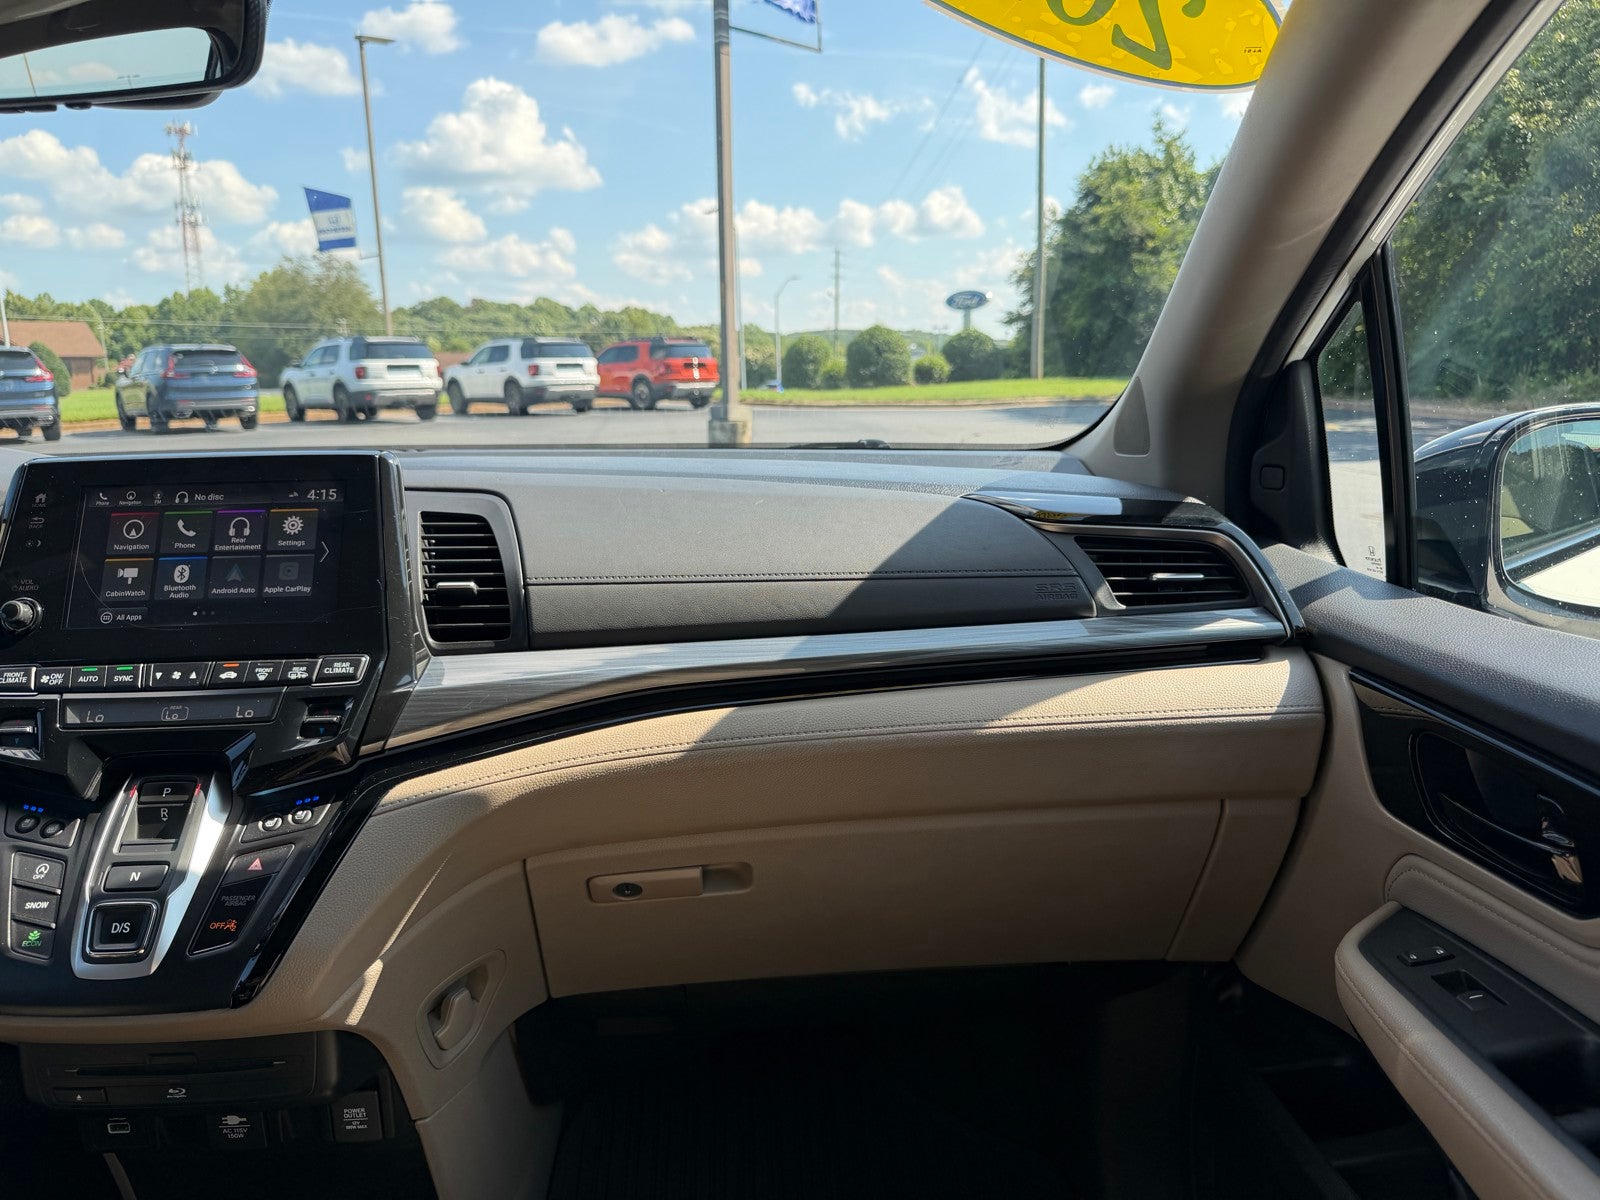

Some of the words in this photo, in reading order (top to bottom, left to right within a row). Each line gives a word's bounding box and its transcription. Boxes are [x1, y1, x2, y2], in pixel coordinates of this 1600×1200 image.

[194, 493, 206, 501] No
[207, 493, 225, 501] disc
[306, 488, 337, 501] 4:15
[113, 543, 150, 551] Navigation
[277, 539, 306, 547] Settings
[163, 584, 197, 592] Bluetooth
[263, 586, 284, 594] Apple
[285, 585, 311, 594] CarPlay
[1035, 583, 1077, 592] SRS
[105, 590, 146, 598] CabinWatch
[1036, 593, 1078, 601] AIRBAG
[126, 614, 142, 622] Apps
[323, 666, 355, 674] CLIMATE
[48, 678, 64, 686] OFF
[77, 675, 99, 683] AUTO
[86, 710, 105, 723] Lo
[165, 710, 179, 720] Lo
[235, 705, 255, 719] Lo
[162, 787, 172, 797] P
[160, 807, 169, 818] R
[129, 871, 142, 882] N
[24, 901, 50, 910] SNOW
[110, 922, 131, 935] D/S
[209, 921, 226, 930] OFF
